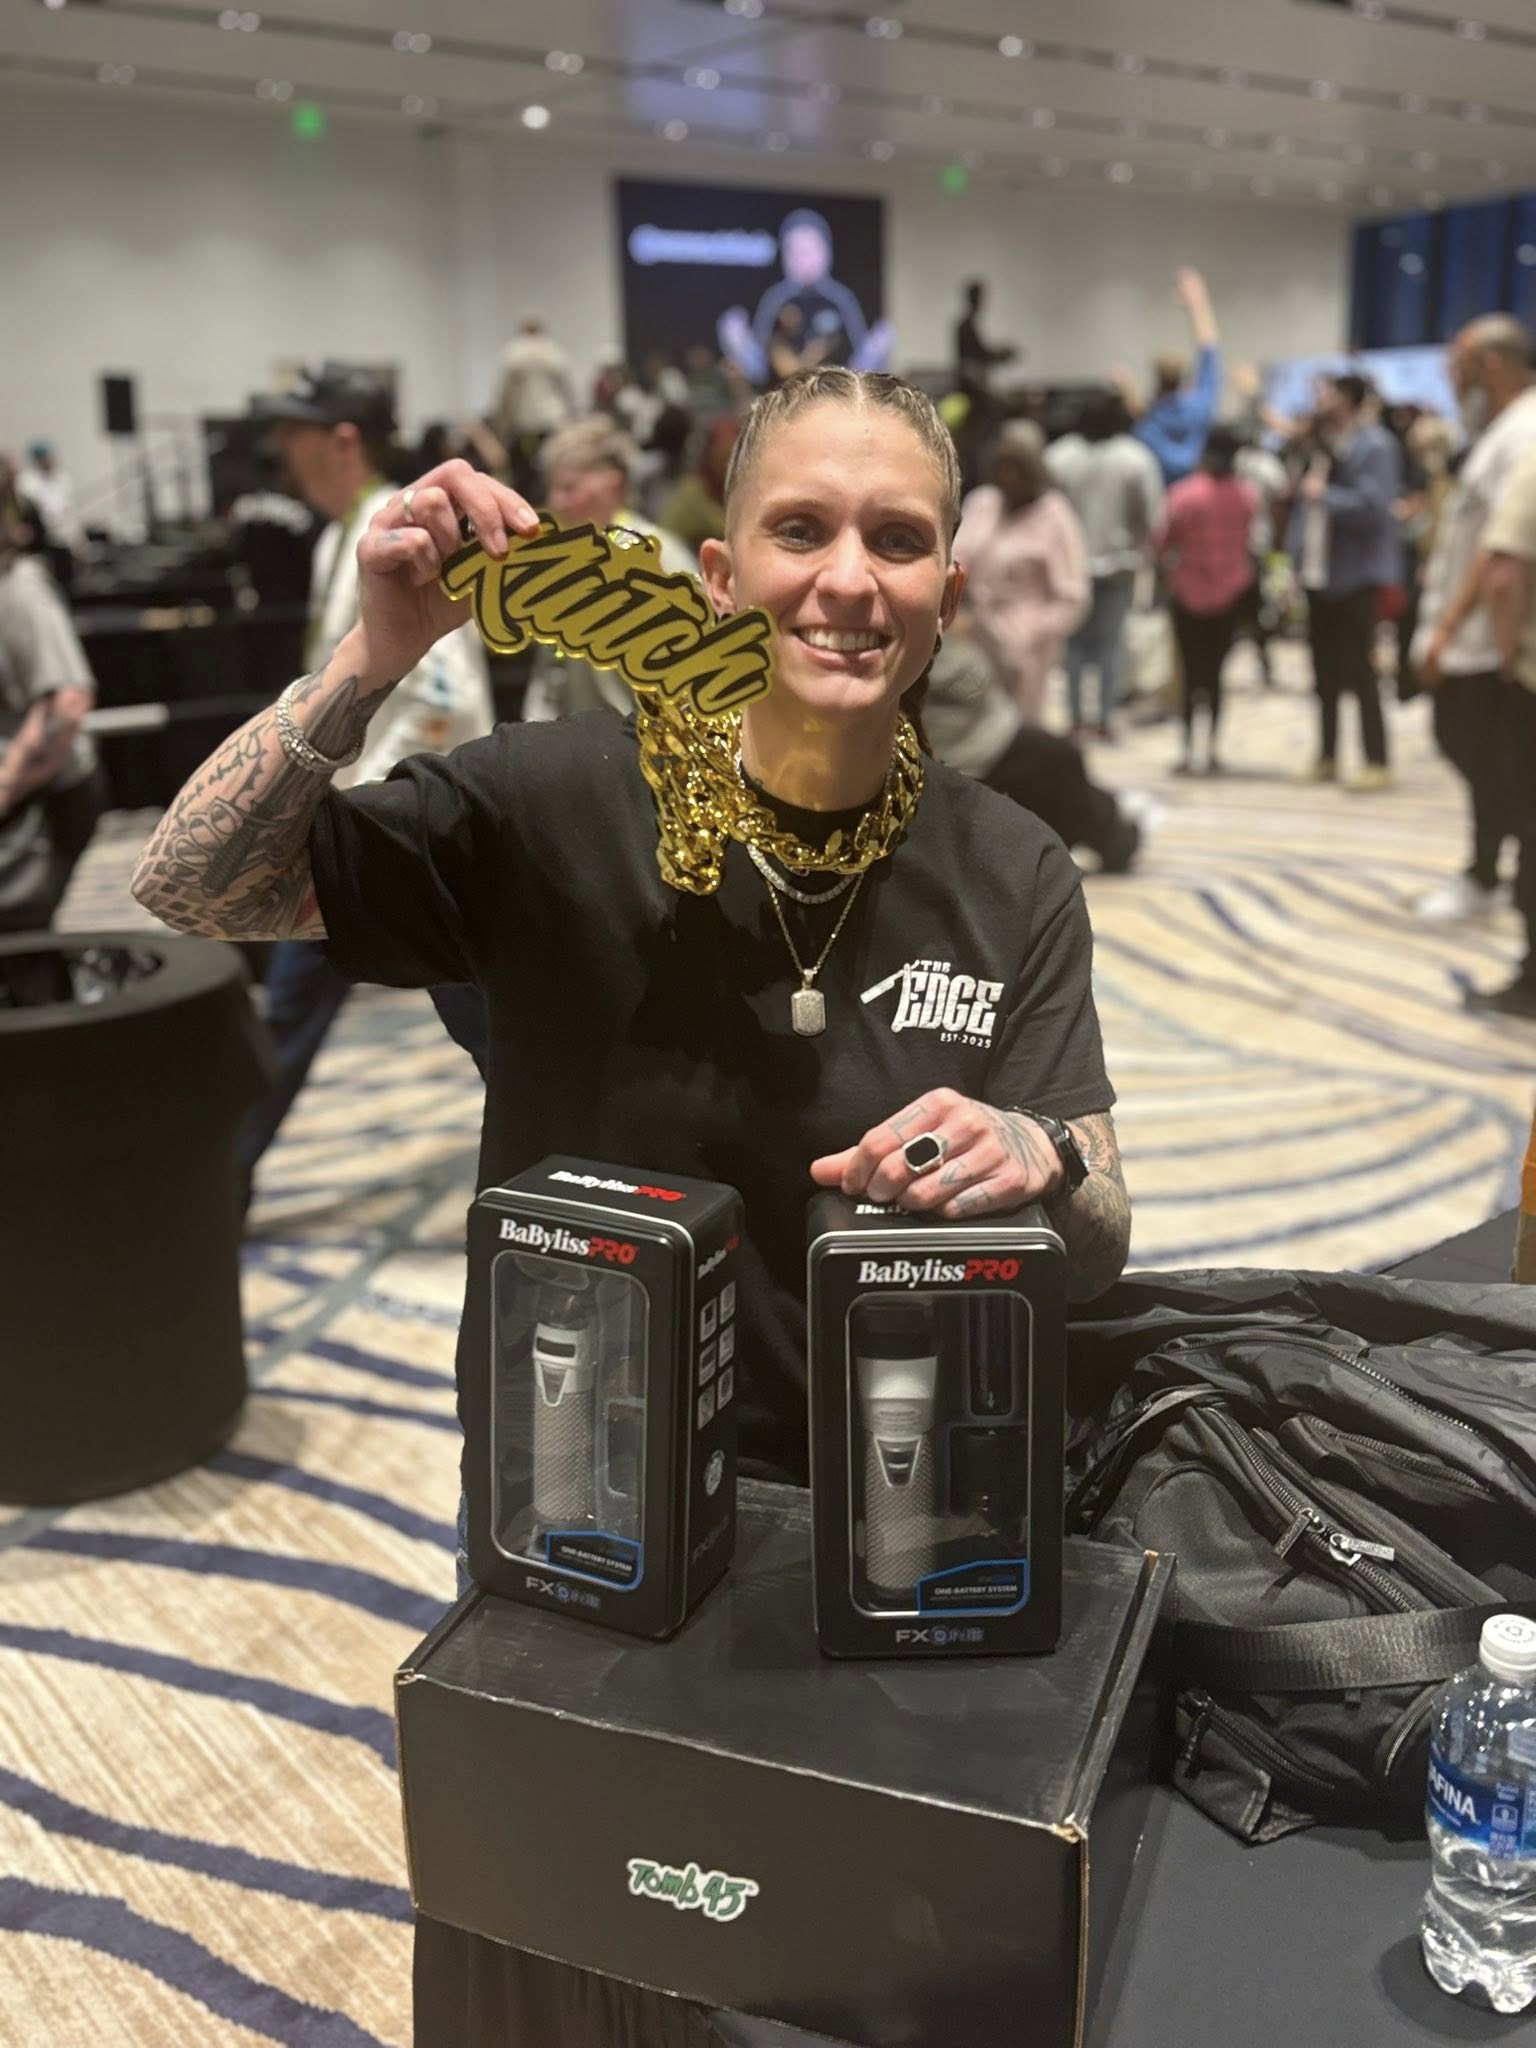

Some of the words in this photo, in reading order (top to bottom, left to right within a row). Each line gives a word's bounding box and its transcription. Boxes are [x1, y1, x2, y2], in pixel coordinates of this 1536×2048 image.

[917, 959, 951, 973] THE
[891, 964, 1004, 1036] EDGE
[499, 1217, 639, 1265] BaBylissPRO
[857, 1258, 1022, 1288] BaBylissPRO
